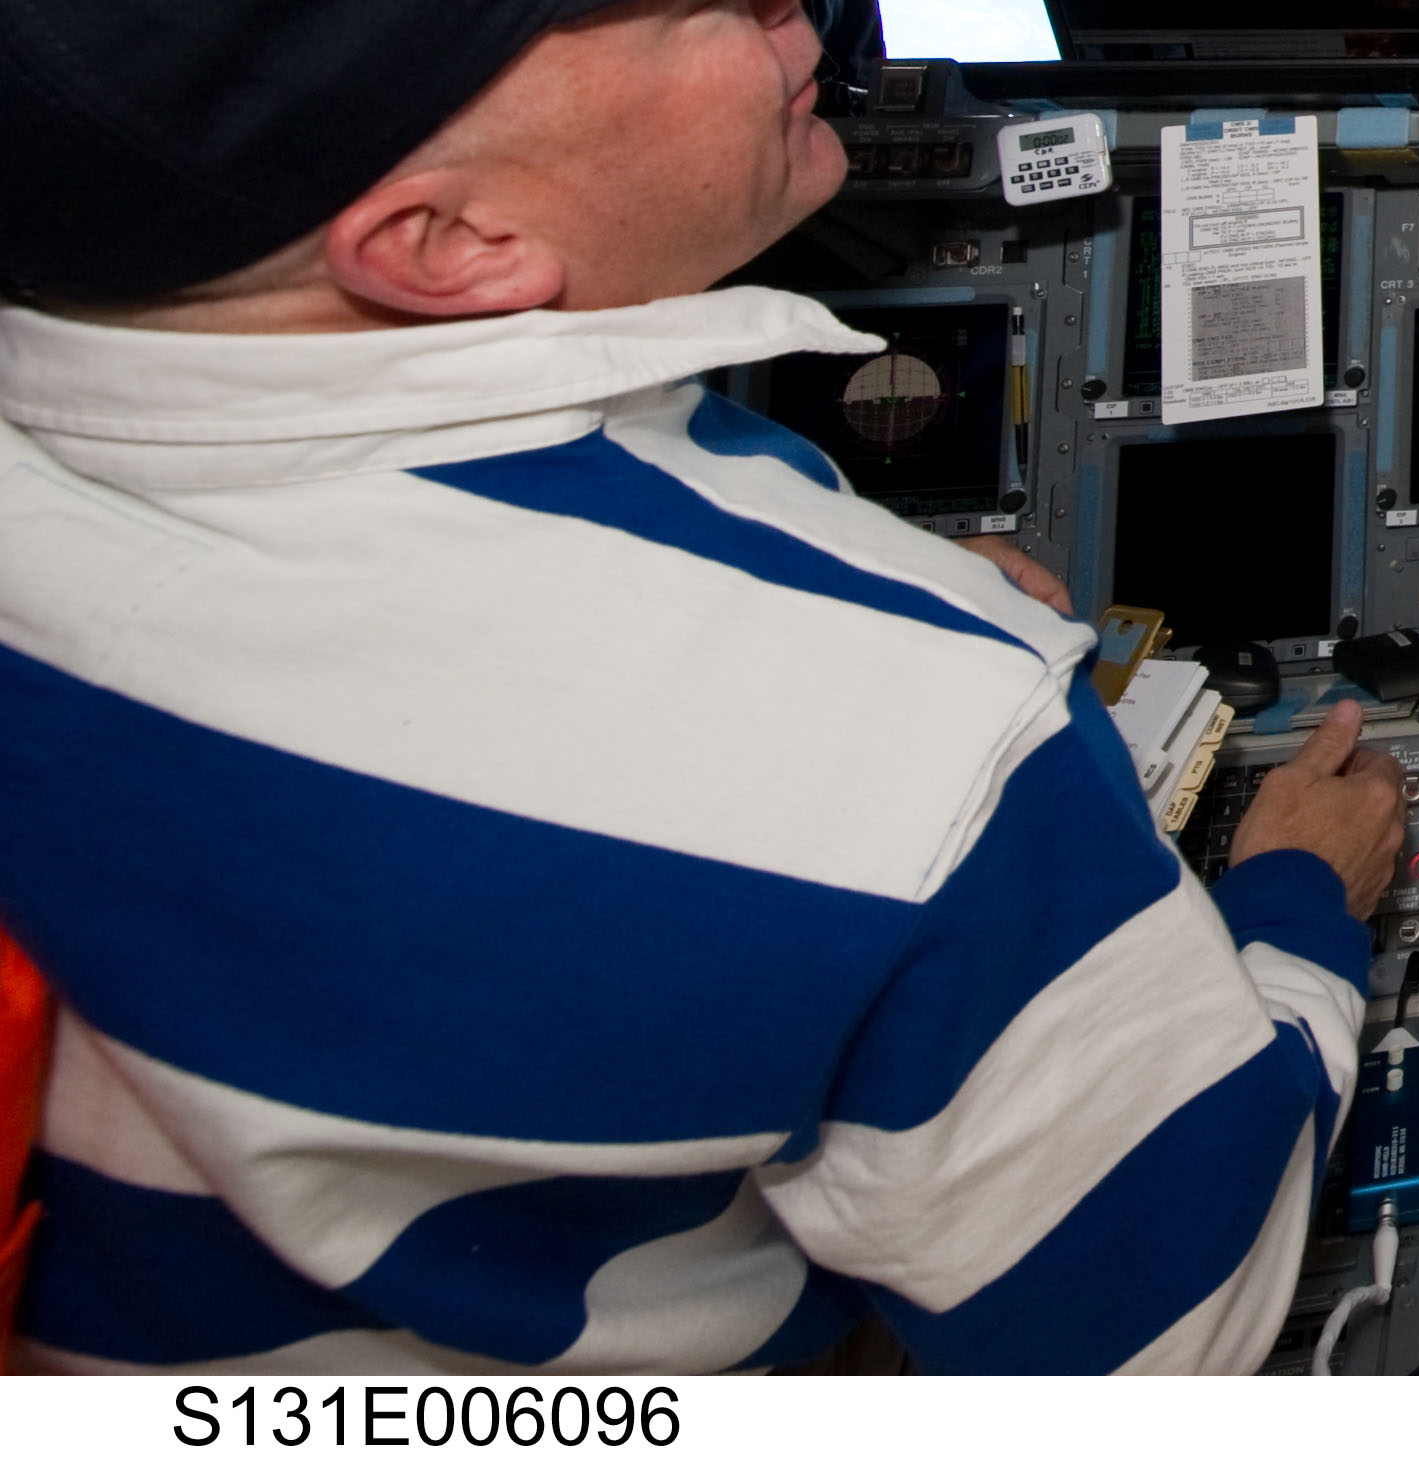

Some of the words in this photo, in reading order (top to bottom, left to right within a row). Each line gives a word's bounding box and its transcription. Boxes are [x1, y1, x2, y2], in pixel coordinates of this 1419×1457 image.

[1401, 223, 1415, 232] F7
[969, 266, 1003, 276] CDR2
[1380, 279, 1403, 288] CRT
[1406, 279, 1414, 288] 3
